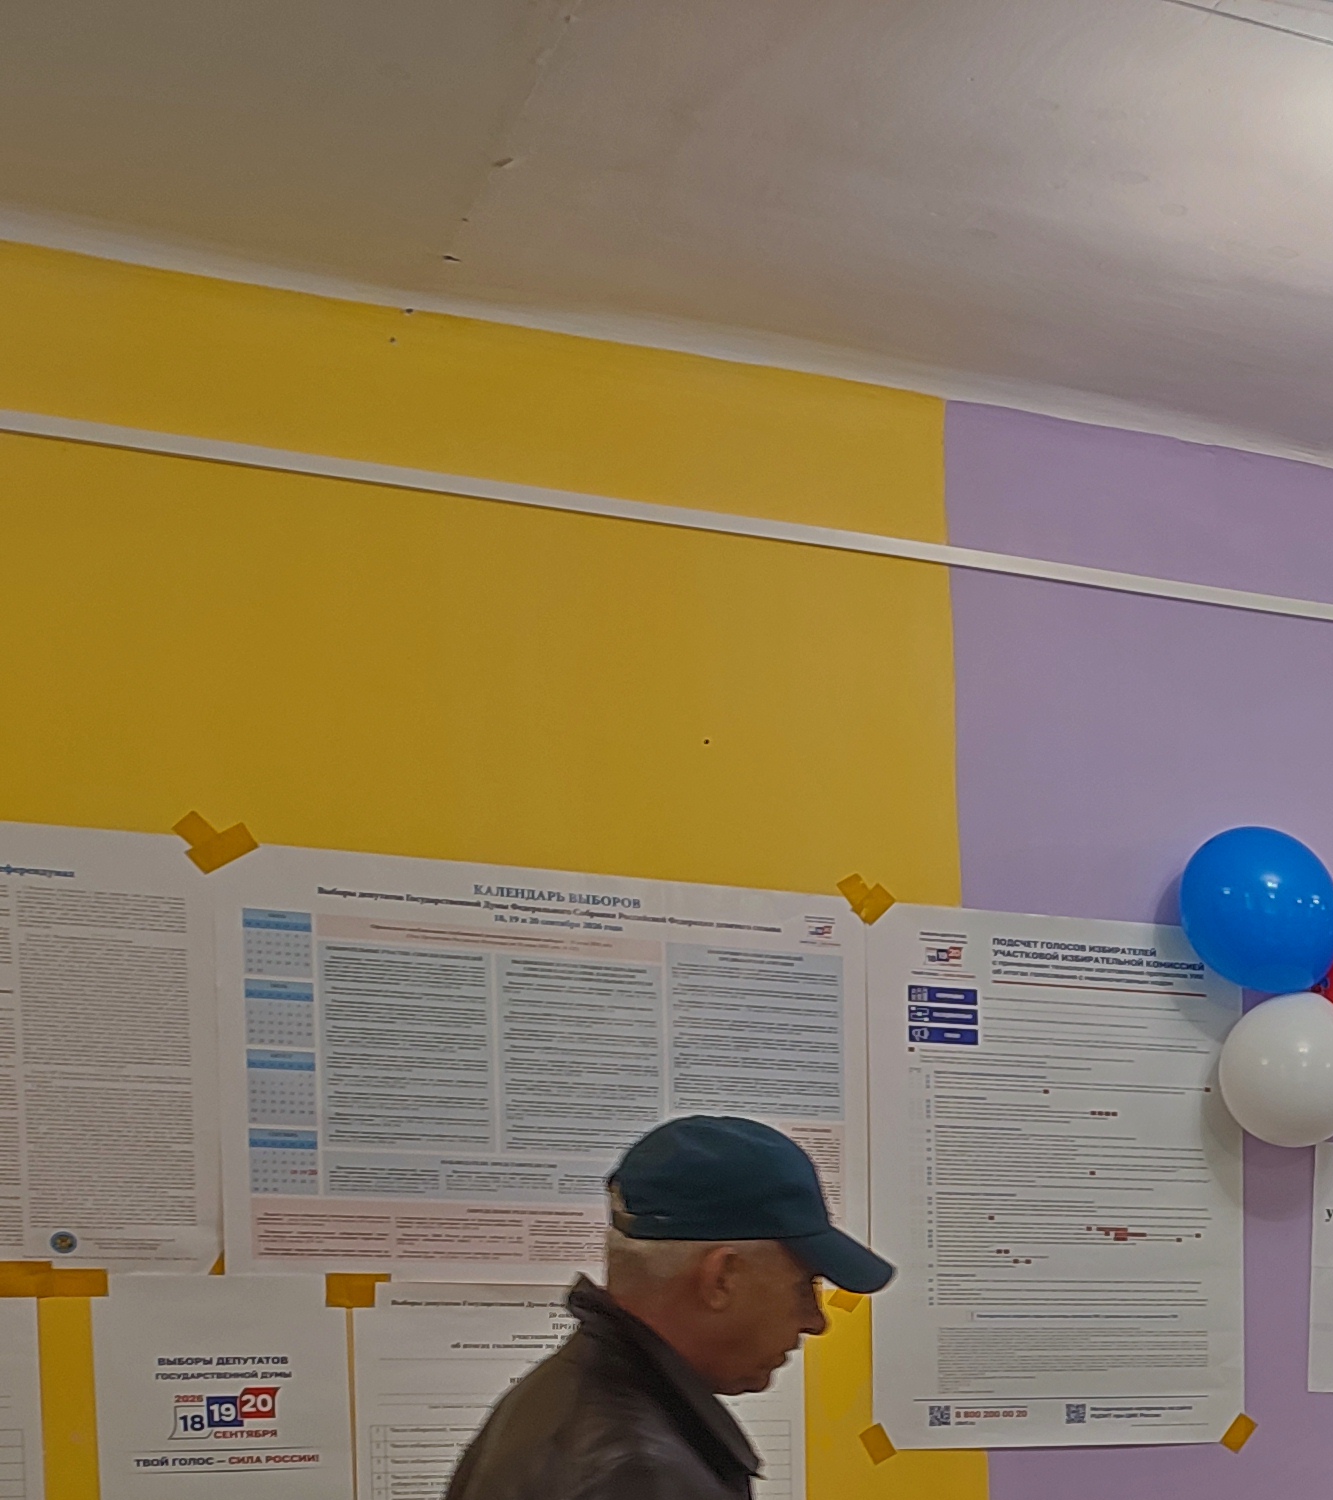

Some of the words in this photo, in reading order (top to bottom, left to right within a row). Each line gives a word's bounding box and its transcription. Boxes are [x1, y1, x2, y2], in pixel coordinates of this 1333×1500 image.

[474, 884, 565, 902] КАЛЕНДАРЬ
[568, 891, 641, 909] ВЫБОРОВ
[992, 937, 1039, 949] ПОДСЧЕТ
[1040, 941, 1087, 952] ГОЛОСОВ
[1088, 945, 1157, 957] ИЗБИРАТЕЛЕЙ
[992, 948, 1059, 961] УЧАСТКОВОЙ
[1061, 953, 1144, 967] ИЗБИРАТЕЛЬНОЙ
[1145, 960, 1205, 971] КОМИССИЕЙ
[157, 1356, 214, 1367] ВЫБОРЫ
[215, 1356, 289, 1367] ДЕПУТАТОВ
[155, 1370, 259, 1381] ГОСУДАРСТВЕННОЙ
[259, 1371, 293, 1380] ДУМЫ
[178, 1414, 205, 1432] 18
[209, 1403, 236, 1422] 19
[241, 1394, 273, 1413] 20
[213, 1429, 278, 1439] СЕНТЯБРЯ
[134, 1456, 169, 1468] ТВОЙ
[172, 1456, 215, 1467] ГОЛОС
[228, 1456, 263, 1465] СИЛА
[265, 1454, 320, 1465] РОССИИ!
